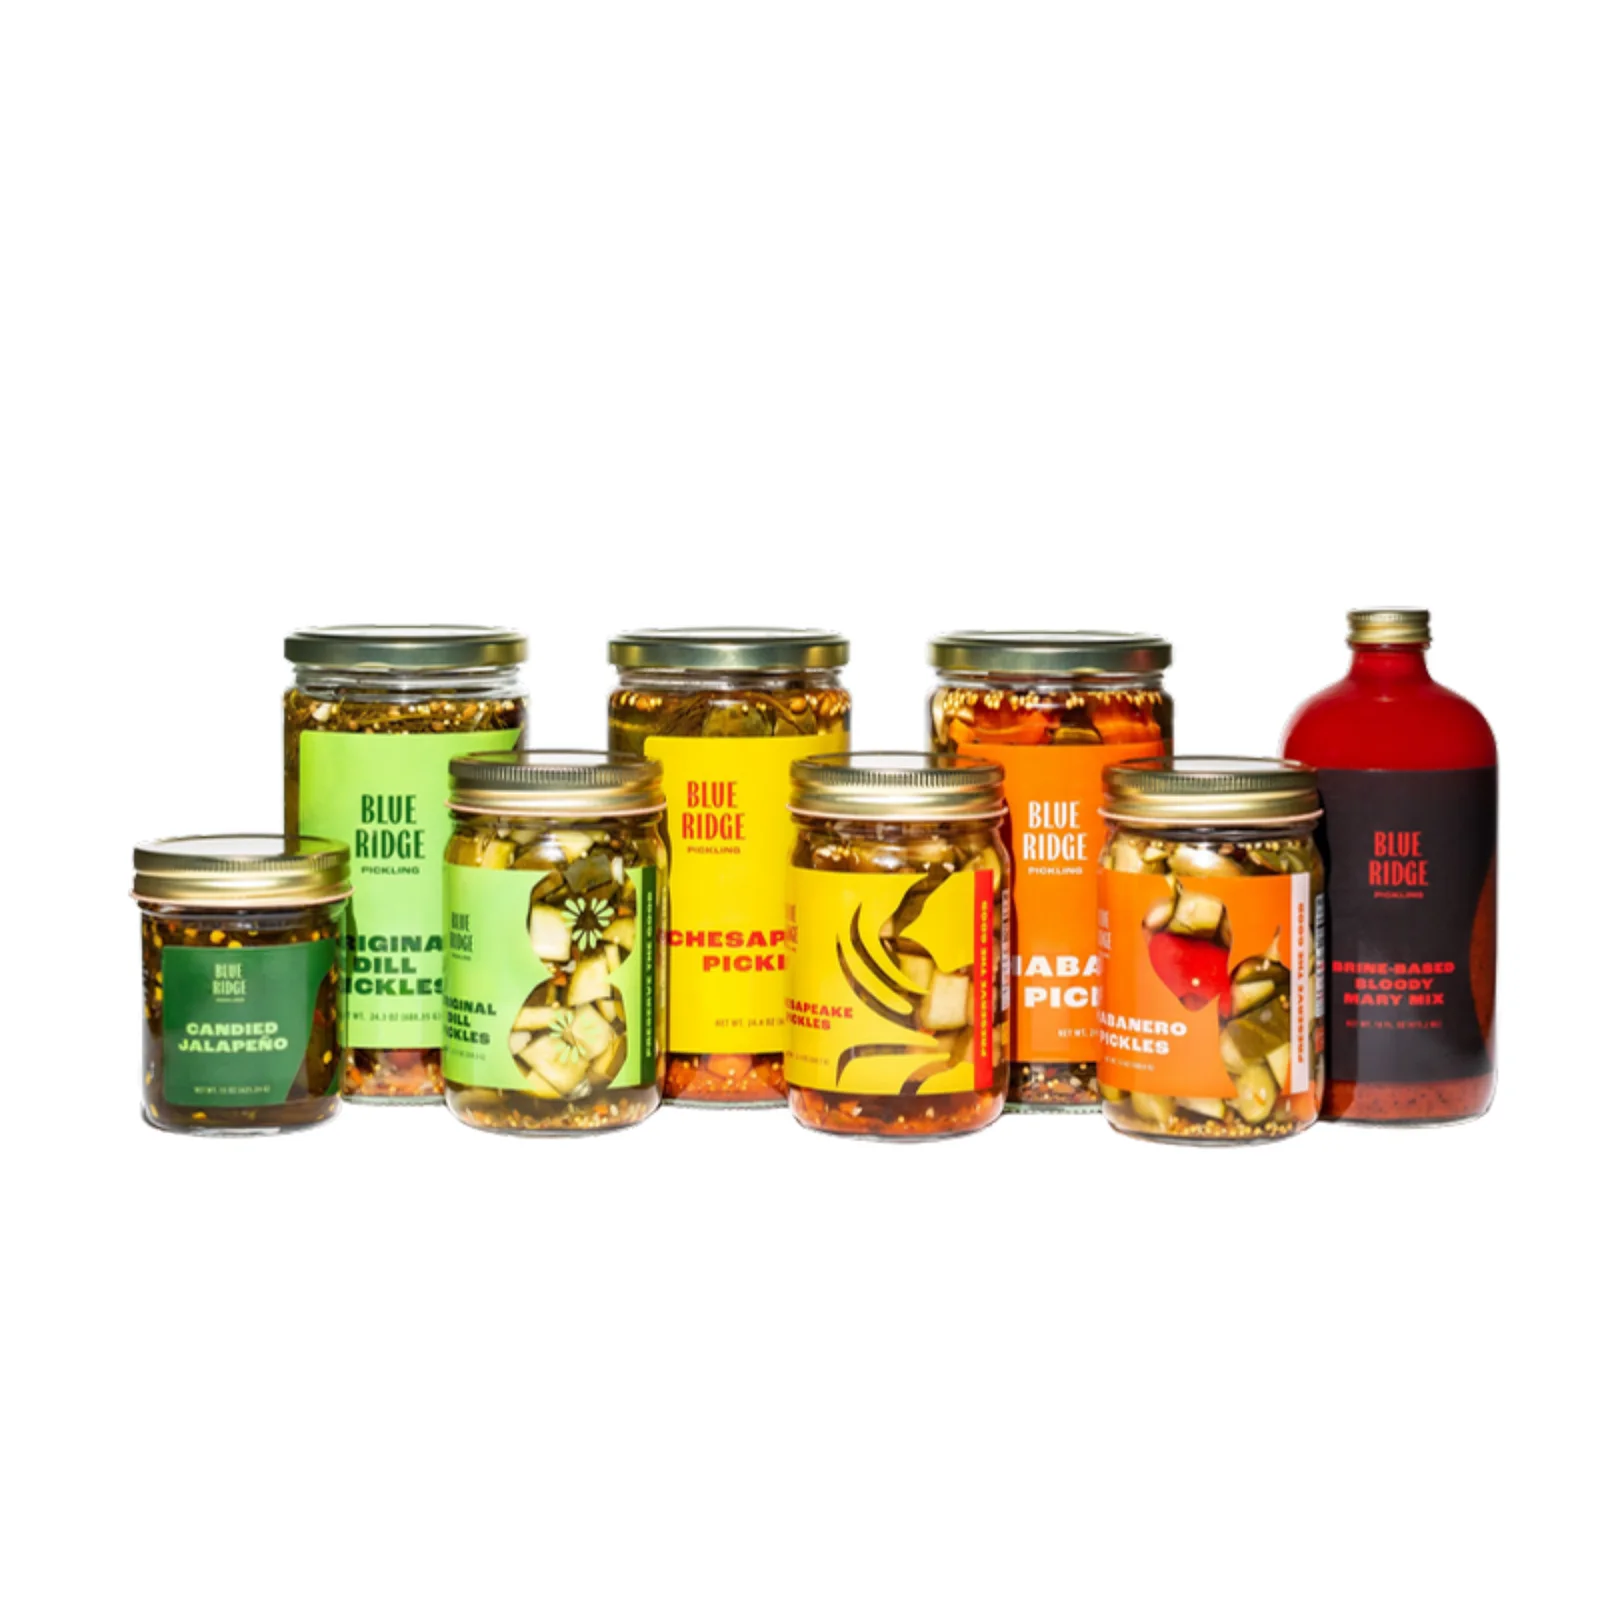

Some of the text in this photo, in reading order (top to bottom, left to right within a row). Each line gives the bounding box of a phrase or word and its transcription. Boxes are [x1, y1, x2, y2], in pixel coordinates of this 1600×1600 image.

[687, 781, 737, 809] BLUE
[361, 794, 417, 825] BLUE
[1028, 801, 1080, 829] BLUE
[681, 812, 745, 841] RIDGE
[355, 829, 425, 859] RIDGE
[687, 846, 741, 855] PICKLING
[1023, 832, 1087, 861] RIDGE
[1374, 831, 1422, 857] BLUE
[361, 866, 420, 875] PICKLING
[1028, 866, 1083, 875] PICKLING
[1369, 860, 1428, 886] RIDGE
[215, 963, 243, 979] BLUE
[354, 957, 417, 974] DILL
[1332, 960, 1455, 975] BRINE-BASED
[212, 979, 246, 995] RIDGE
[1355, 978, 1434, 990] BLOODY
[1343, 993, 1445, 1006] MARY MIX
[185, 1022, 279, 1036] CANDIED
[177, 1035, 289, 1053] JALAPEÑO
